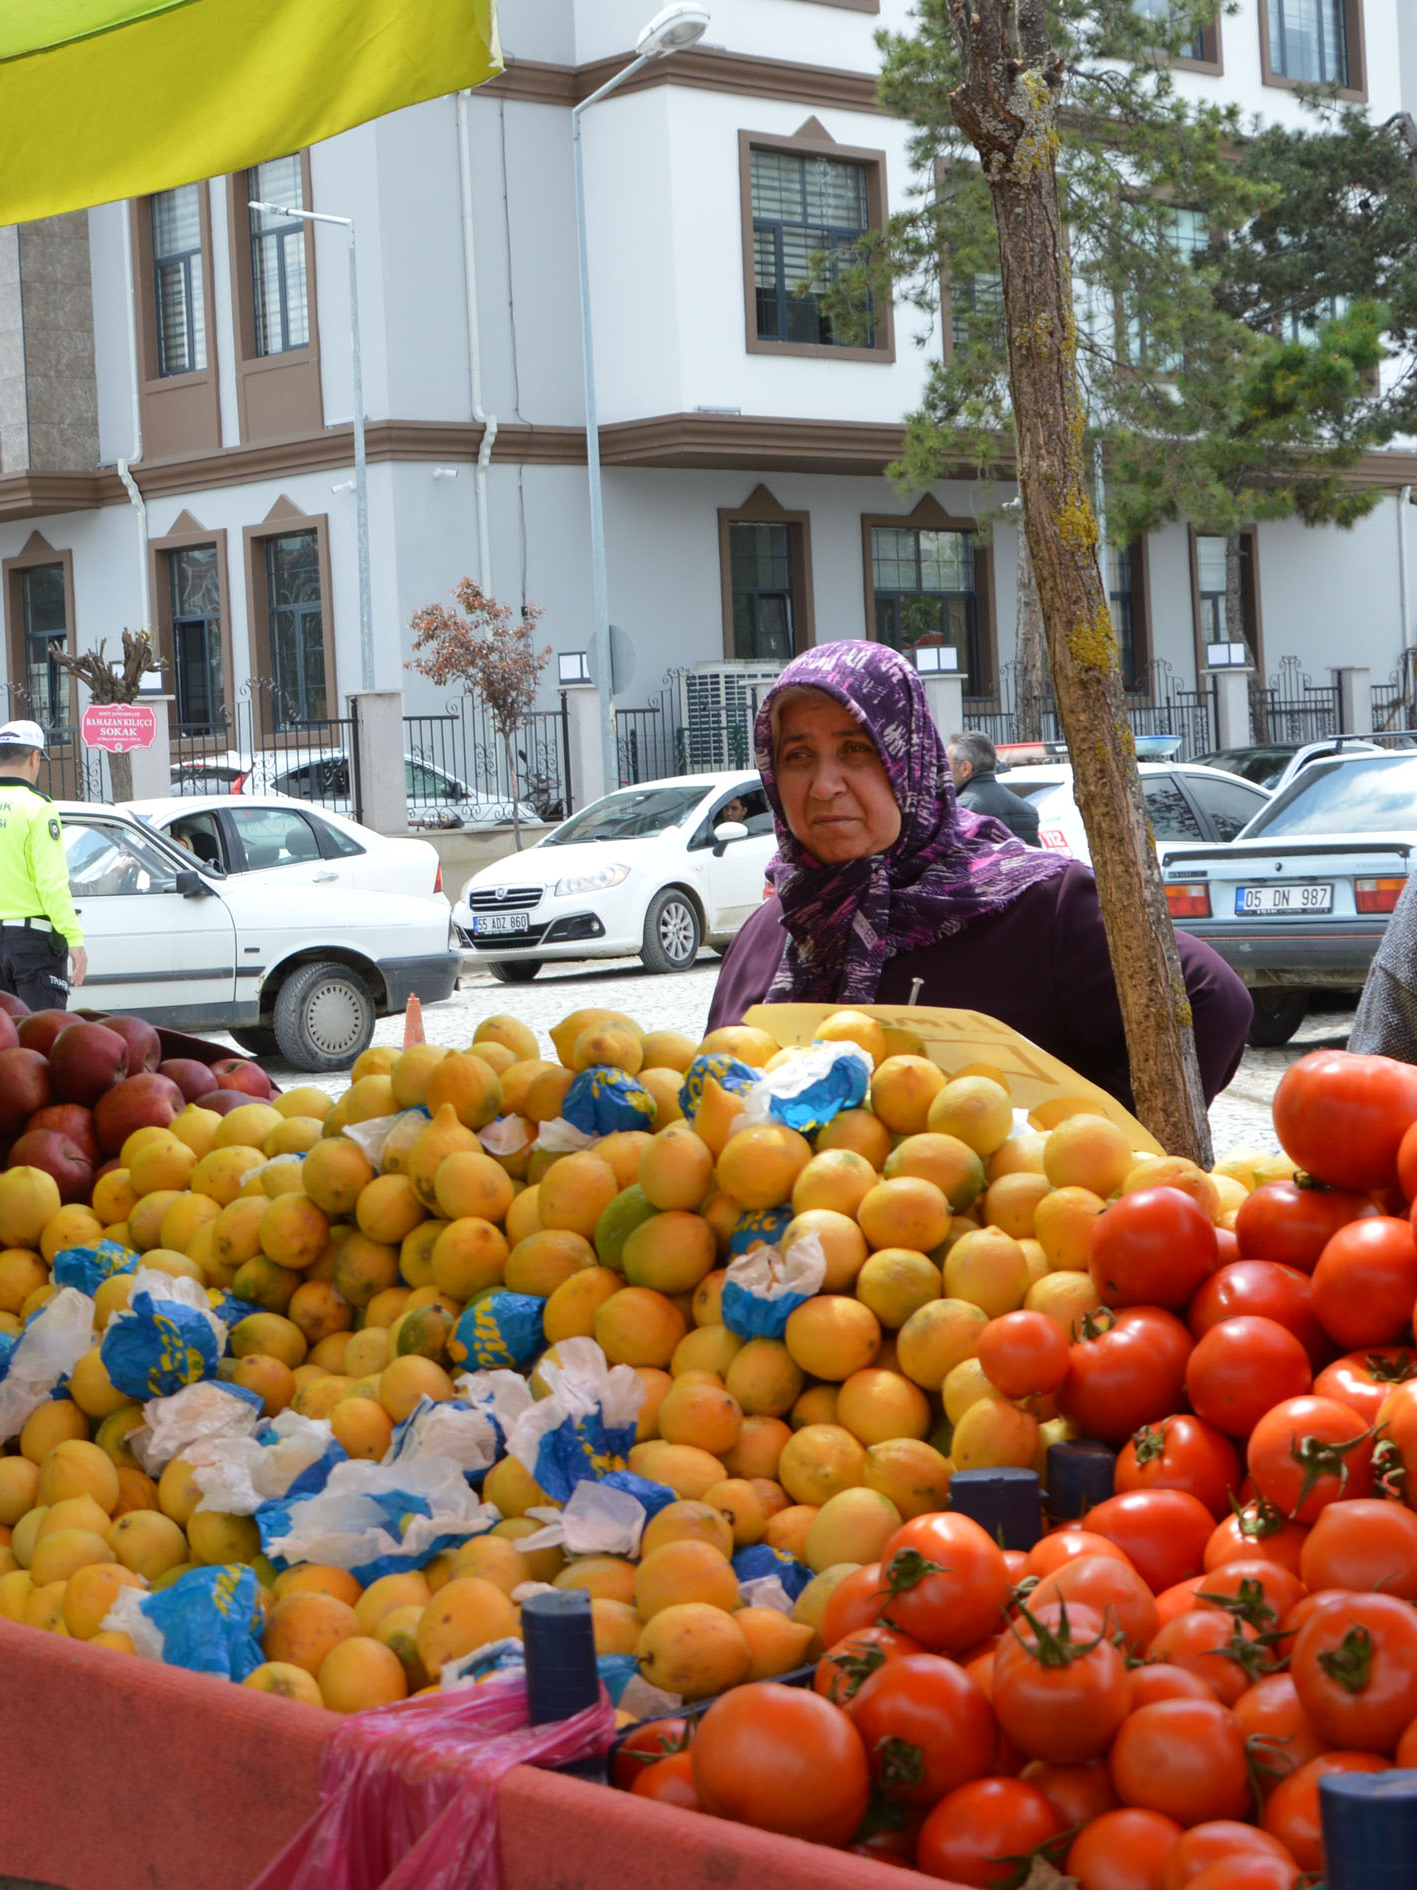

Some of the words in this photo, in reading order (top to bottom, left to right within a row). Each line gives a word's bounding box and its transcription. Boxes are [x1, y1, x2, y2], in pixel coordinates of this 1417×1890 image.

[86, 718, 122, 726] RAMAZAN
[100, 728, 137, 736] SOKAK
[1041, 831, 1064, 848] 112
[1245, 890, 1262, 908] 05
[1273, 890, 1291, 907] DN
[1301, 888, 1328, 905] 987
[478, 916, 488, 931] 55
[491, 916, 507, 930] ADZ
[510, 915, 527, 928] 860
